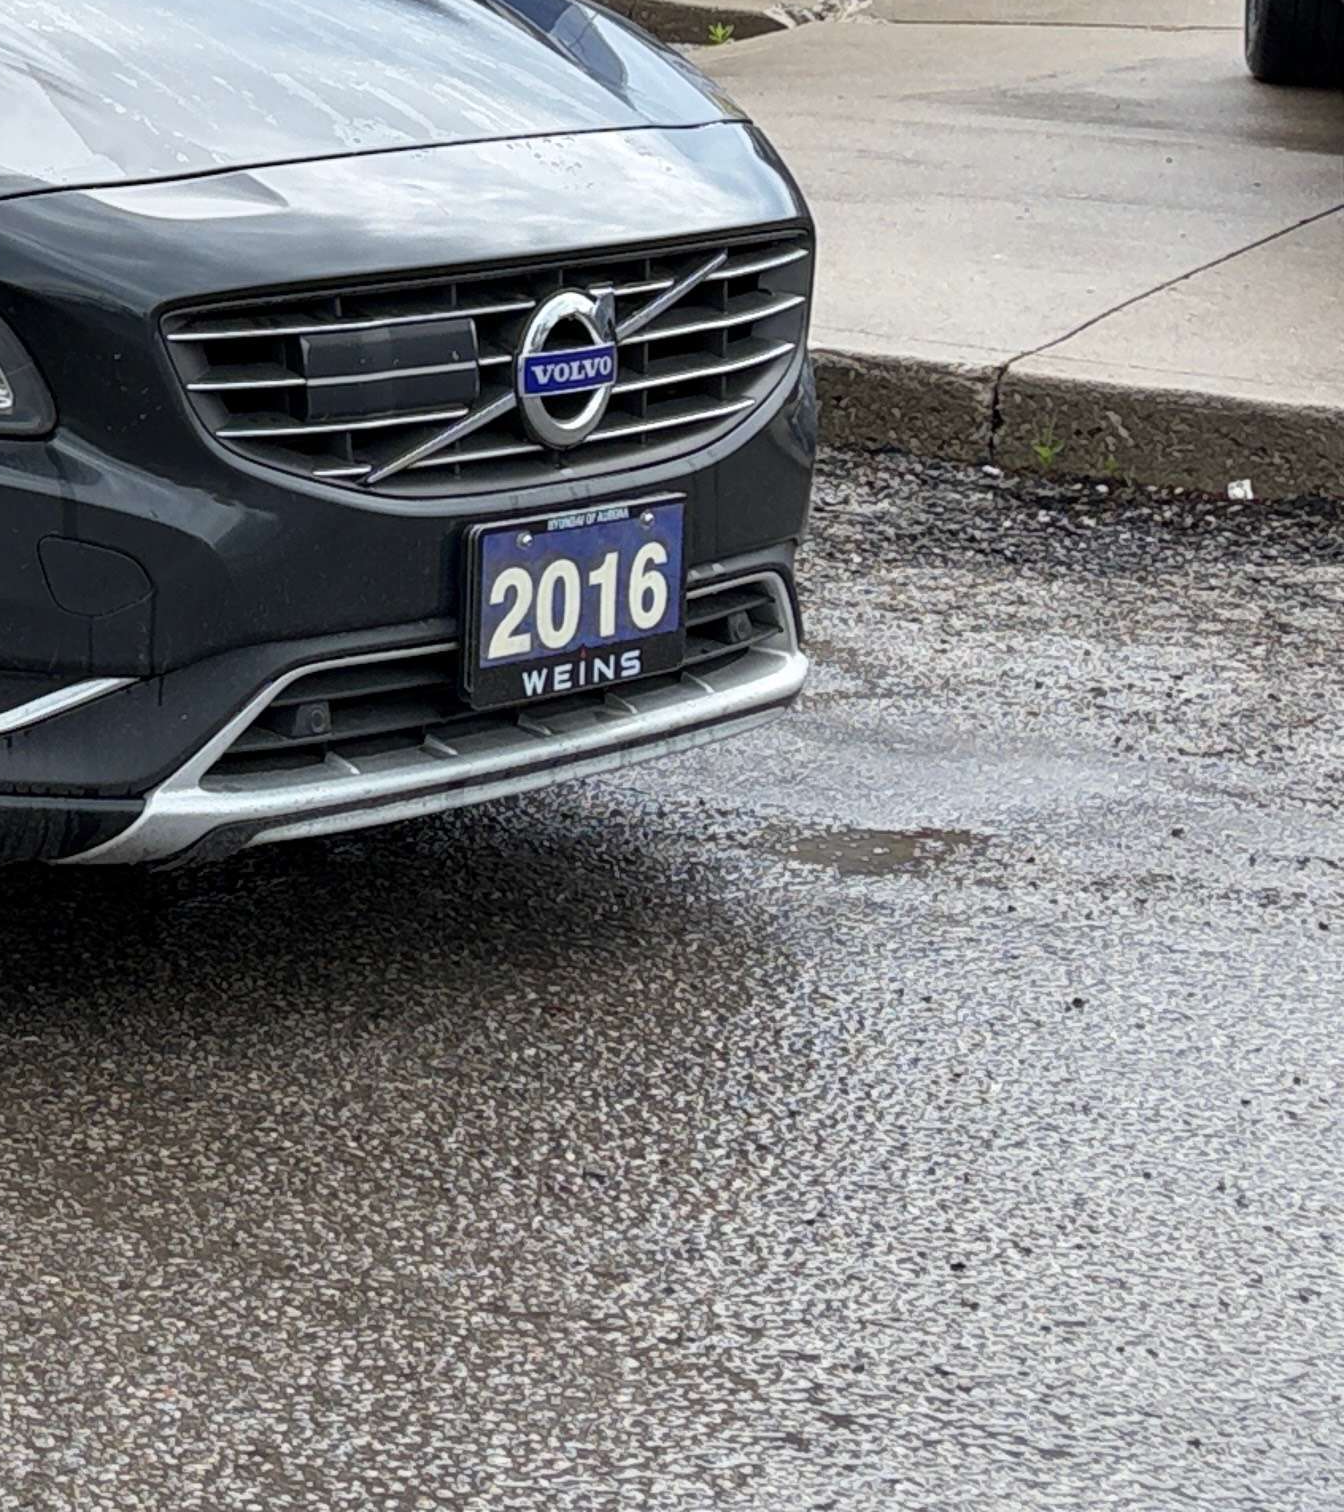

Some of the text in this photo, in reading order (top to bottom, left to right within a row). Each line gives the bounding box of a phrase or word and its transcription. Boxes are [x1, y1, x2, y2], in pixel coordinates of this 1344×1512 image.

[531, 355, 612, 385] VOLVO
[487, 541, 669, 660] 2016
[521, 648, 642, 697] WEINS
